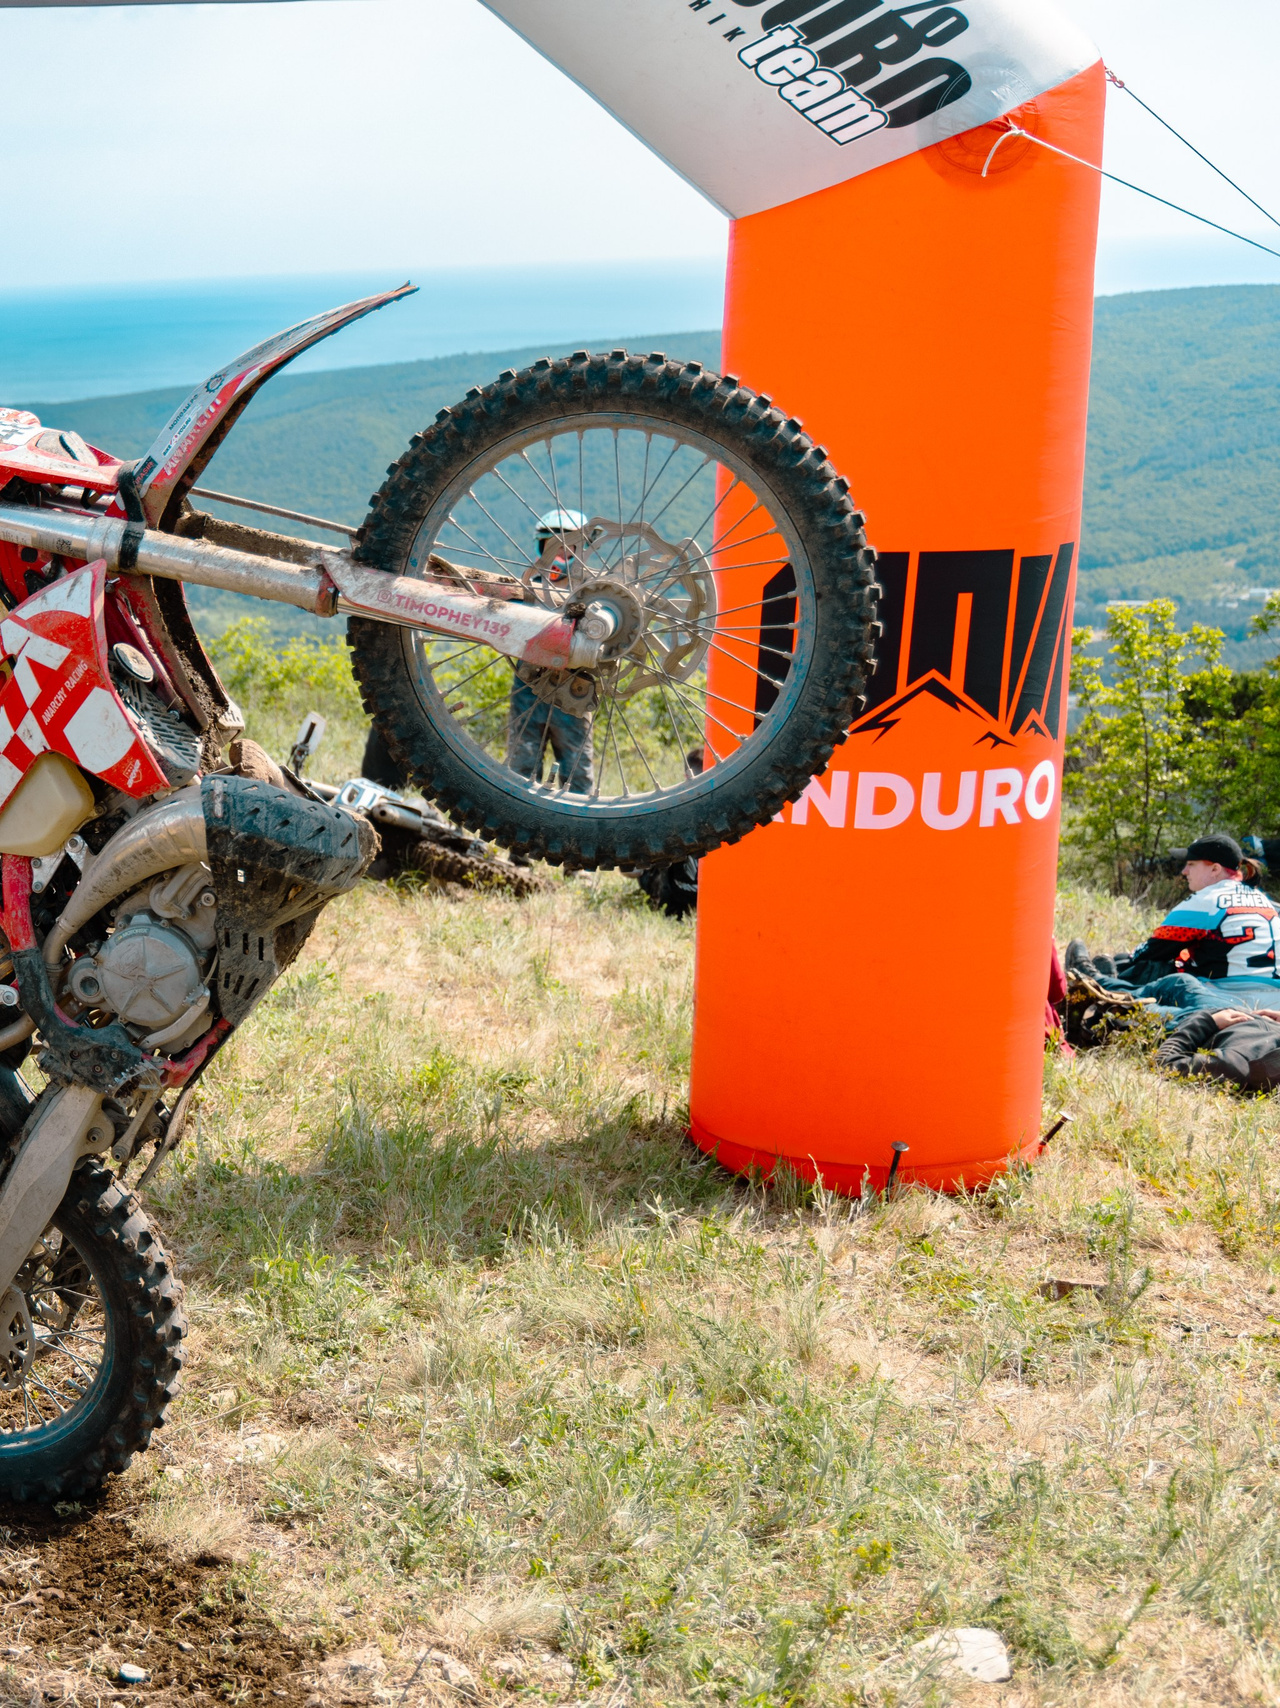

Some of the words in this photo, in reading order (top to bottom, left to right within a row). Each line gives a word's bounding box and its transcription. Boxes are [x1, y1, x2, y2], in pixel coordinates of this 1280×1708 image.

[737, 23, 890, 146] team
[395, 594, 510, 637] TIMOPHEY139
[41, 688, 67, 725] ANARCHY
[64, 660, 89, 692] RACING
[772, 760, 1056, 831] NDURO
